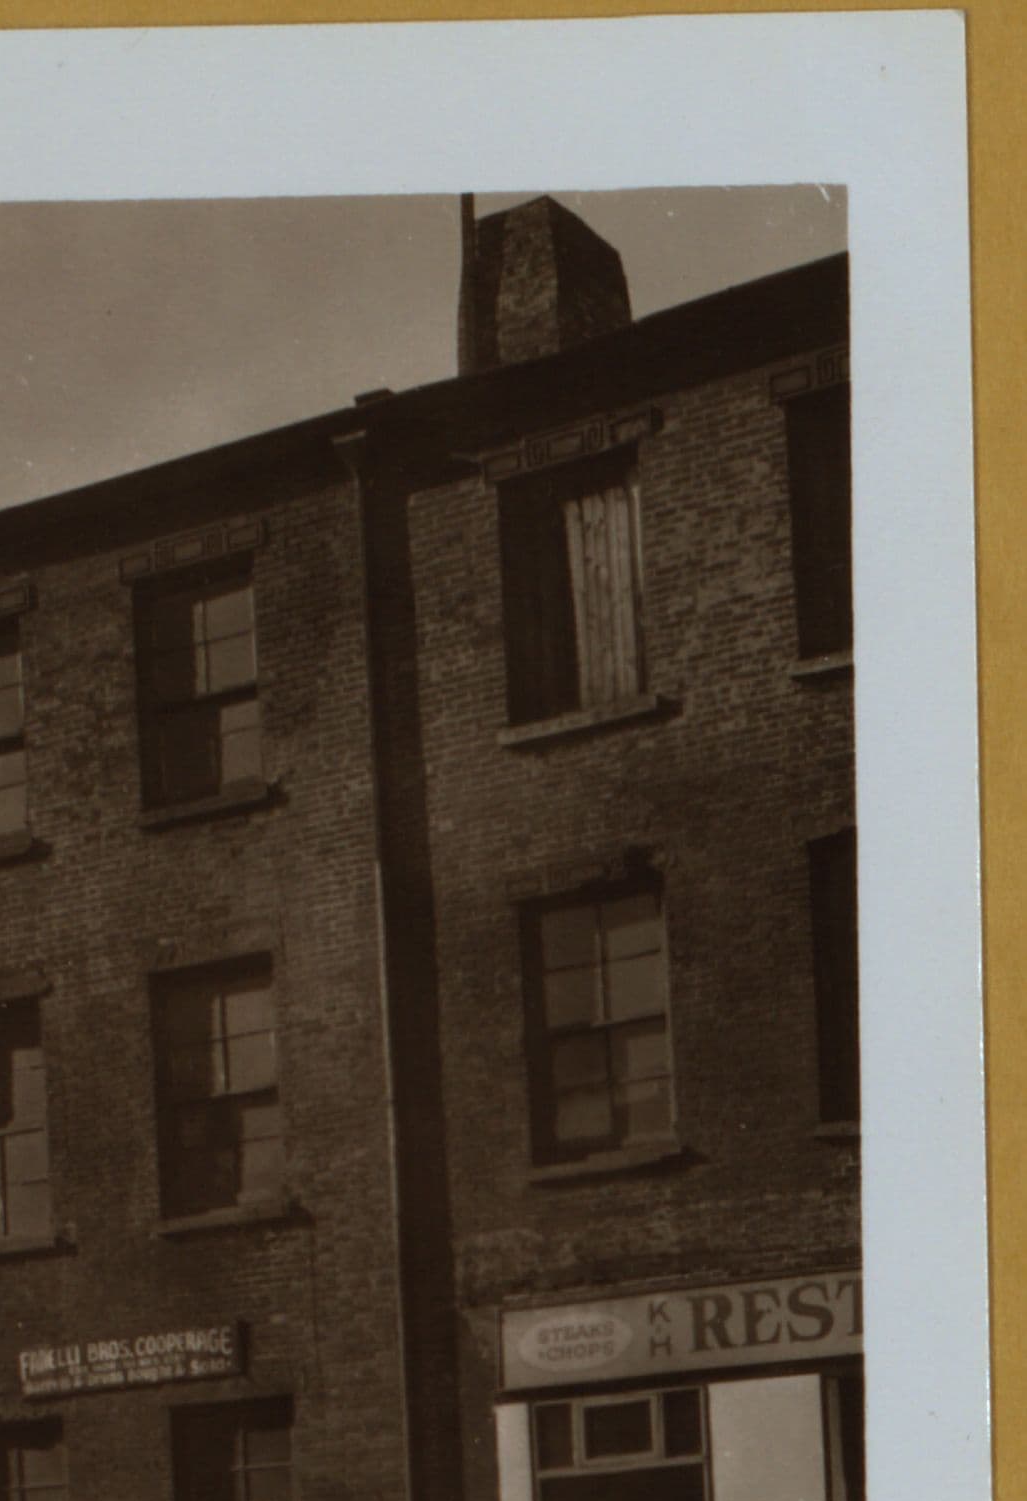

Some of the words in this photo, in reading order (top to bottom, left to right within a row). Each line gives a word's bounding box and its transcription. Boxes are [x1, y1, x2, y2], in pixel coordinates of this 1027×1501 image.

[647, 1301, 671, 1325] K
[687, 1279, 863, 1353] REST
[135, 1325, 233, 1357] COOPERAGE
[537, 1321, 615, 1345] STEAKS
[649, 1335, 673, 1358] H
